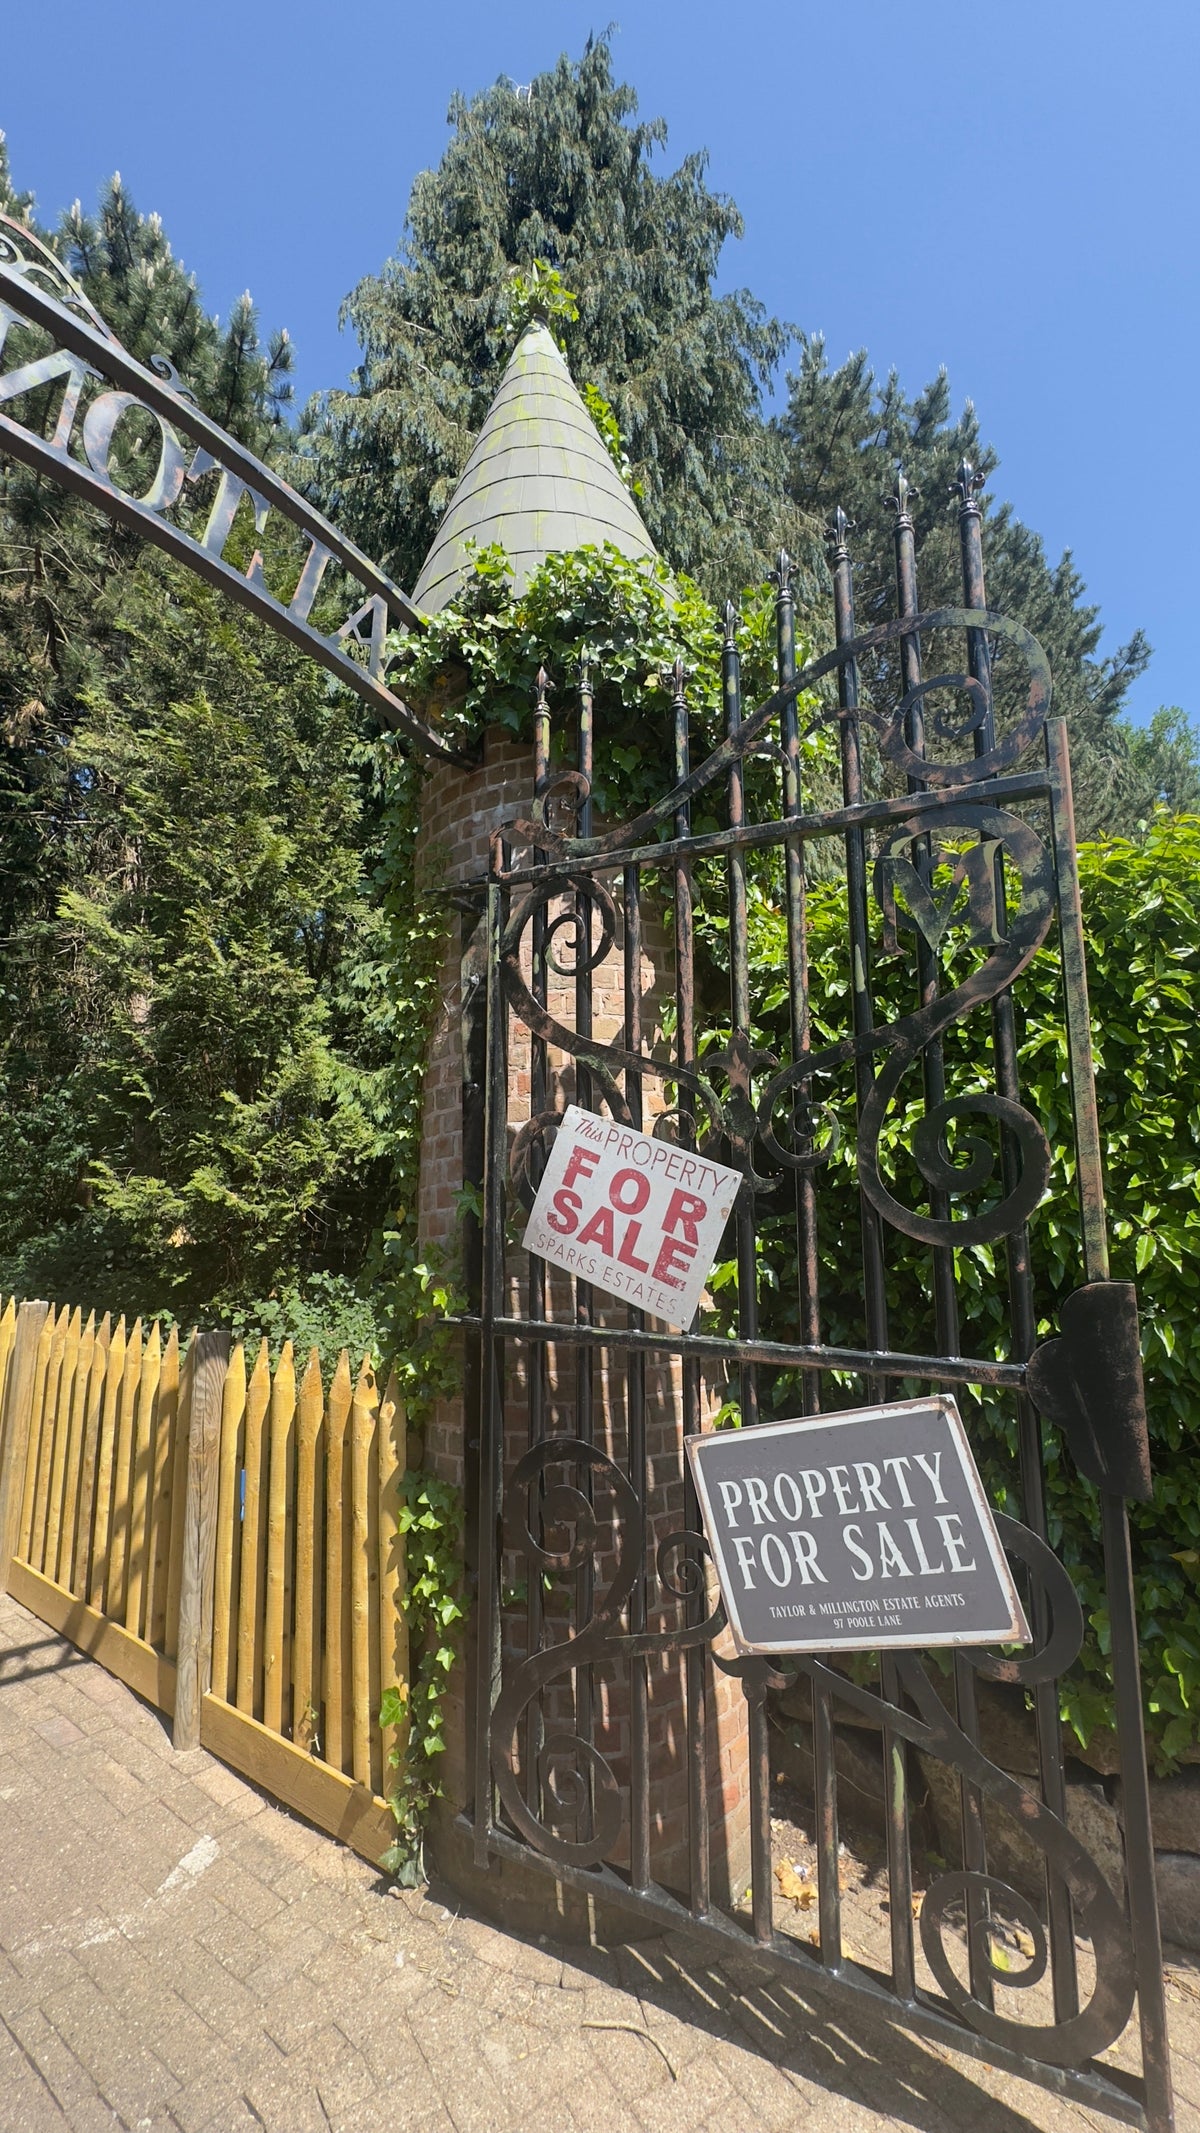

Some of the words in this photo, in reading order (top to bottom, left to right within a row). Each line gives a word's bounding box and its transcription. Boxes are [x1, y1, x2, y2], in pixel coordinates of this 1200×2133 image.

[562, 1145, 707, 1245] FOR
[575, 1118, 603, 1141] This
[603, 1128, 728, 1196] PROPERTY
[537, 1233, 597, 1274] SPARKS
[603, 1267, 676, 1314] ESTATES
[547, 1189, 697, 1291] SALE
[717, 1452, 949, 1528] PROPERTY
[731, 1531, 830, 1590] FOR
[842, 1514, 976, 1581] SALE
[769, 1604, 806, 1619] TAYLOR
[808, 1604, 816, 1616] &
[819, 1600, 881, 1615] MILLINGTON
[883, 1597, 921, 1611] ESTATE
[924, 1593, 966, 1608] AGENTS
[833, 1618, 844, 1629] 97
[847, 1617, 876, 1629] POOLE
[878, 1614, 902, 1627] LANE
